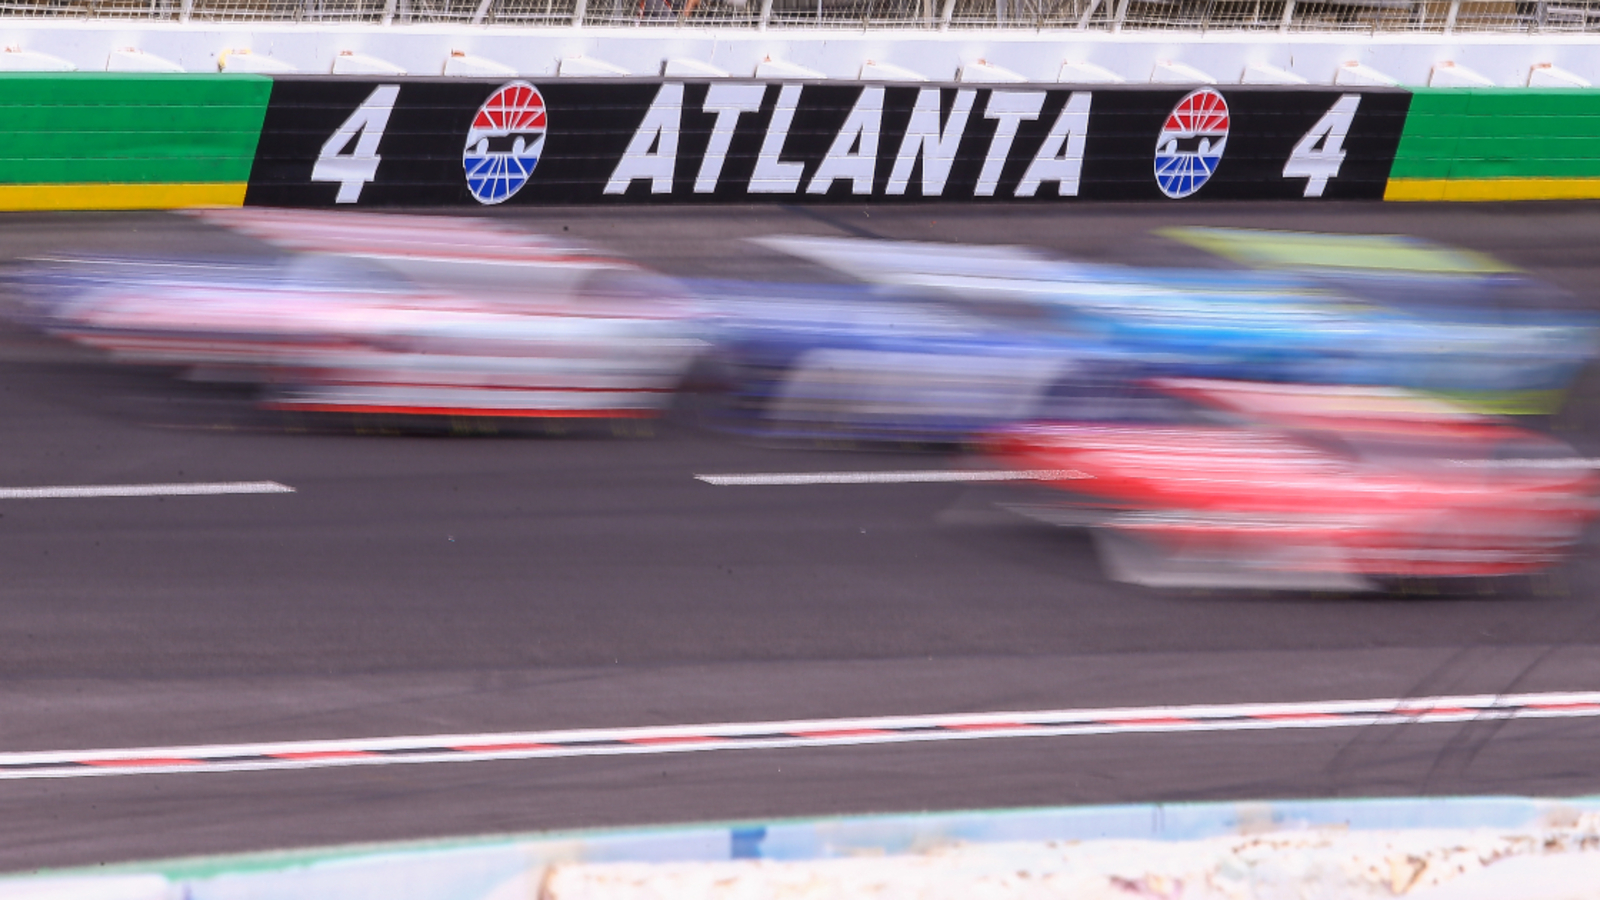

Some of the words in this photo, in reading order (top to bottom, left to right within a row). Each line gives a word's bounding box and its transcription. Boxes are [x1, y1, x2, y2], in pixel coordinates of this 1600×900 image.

[311, 84, 400, 203] 4
[603, 82, 1092, 196] ATLANTA
[1283, 94, 1361, 197] 4
